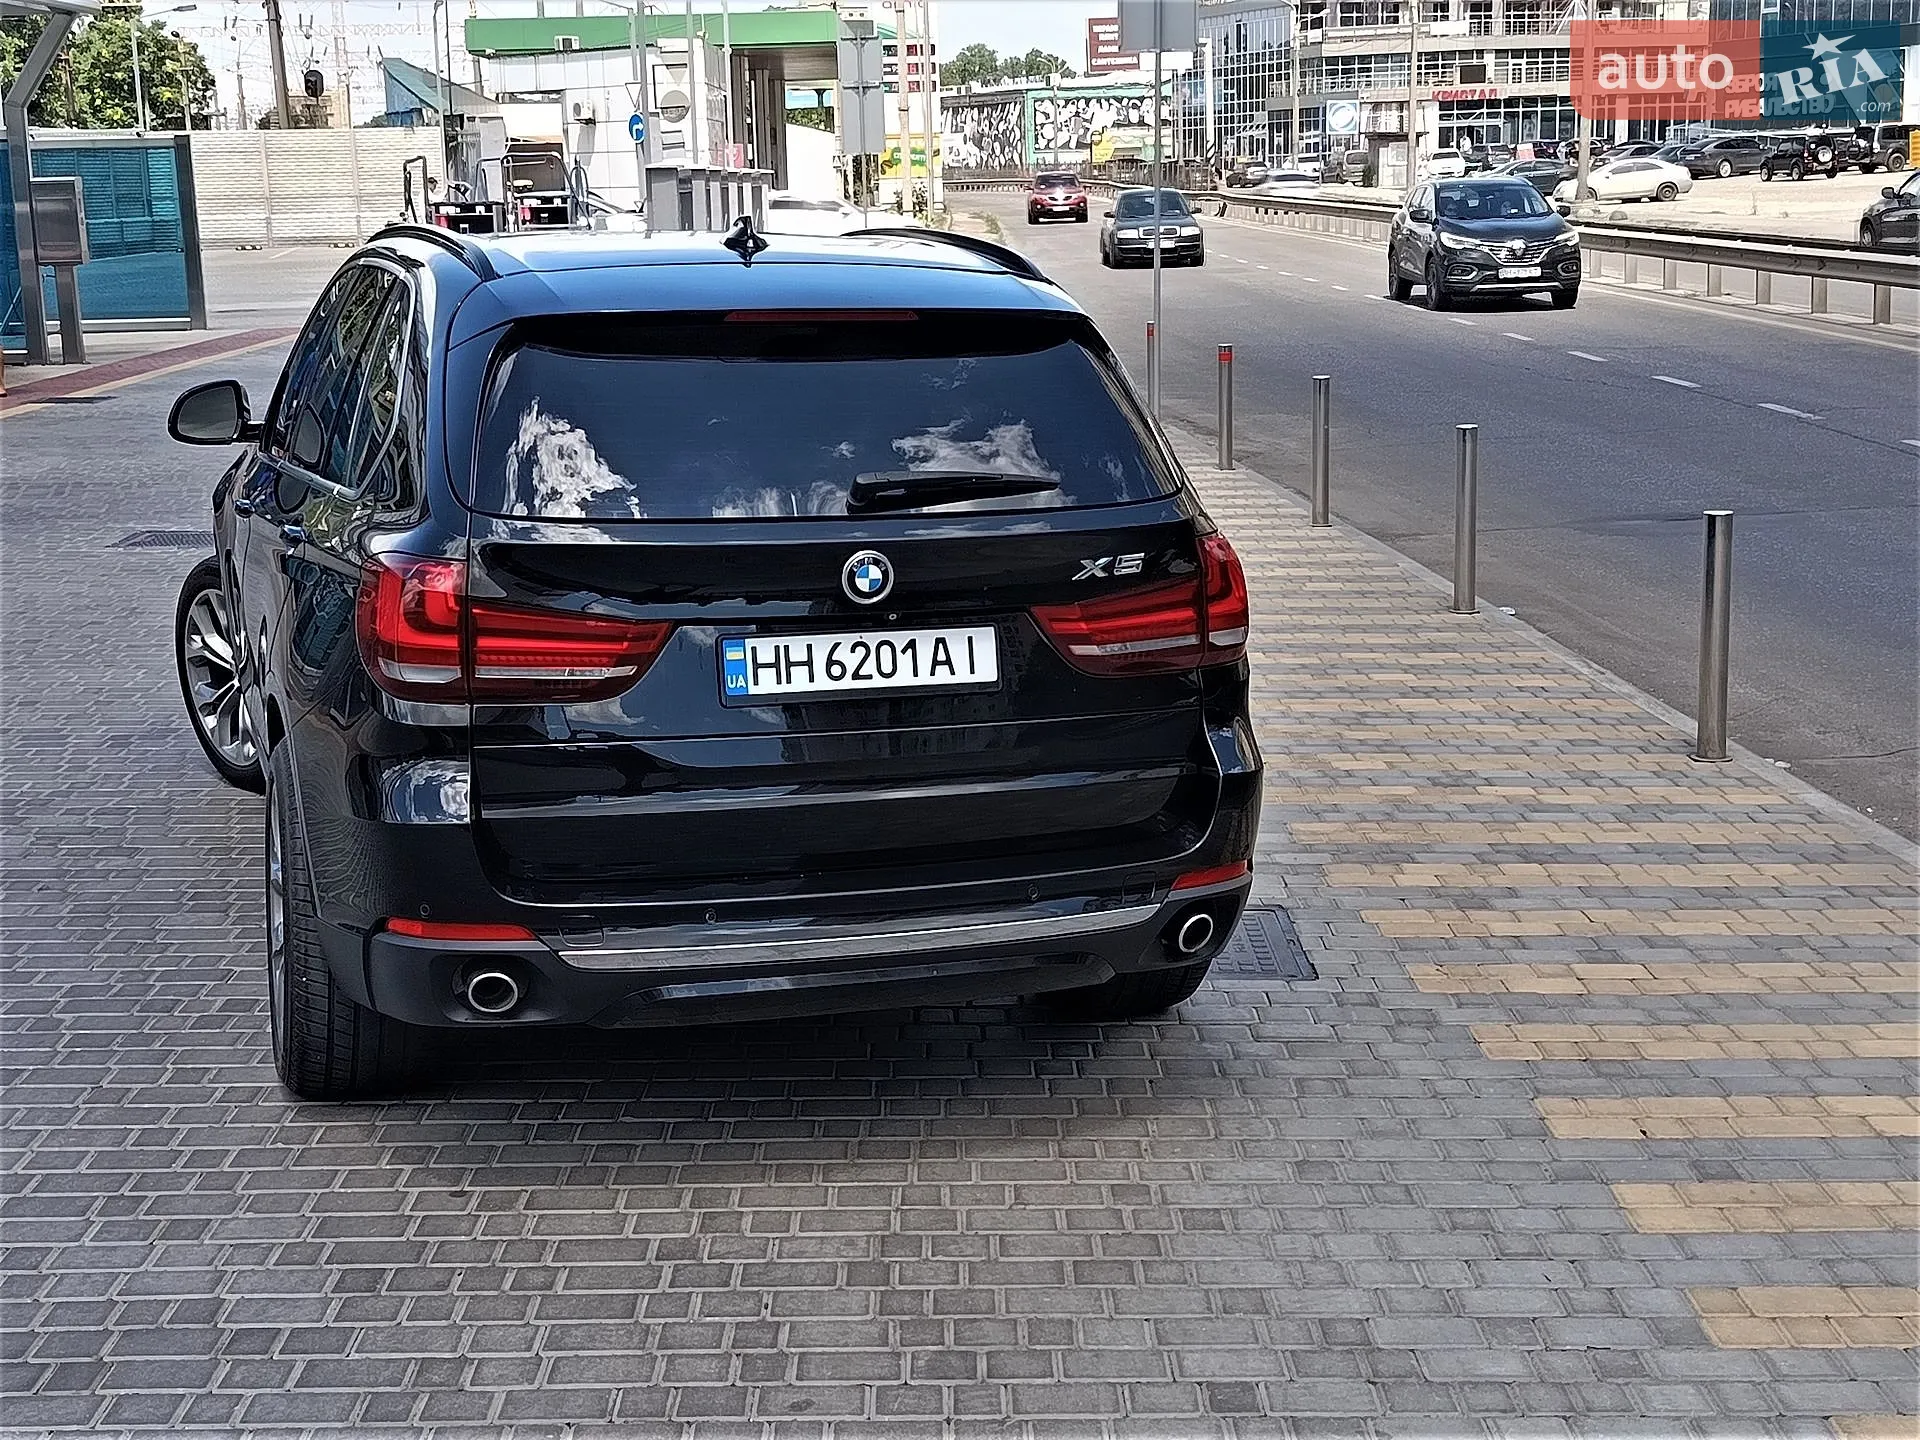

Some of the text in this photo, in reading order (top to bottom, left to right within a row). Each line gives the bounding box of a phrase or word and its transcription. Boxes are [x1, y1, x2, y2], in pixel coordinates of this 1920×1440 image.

[852, 557, 887, 572] BMW
[1072, 553, 1145, 580] X5
[727, 674, 748, 689] UA
